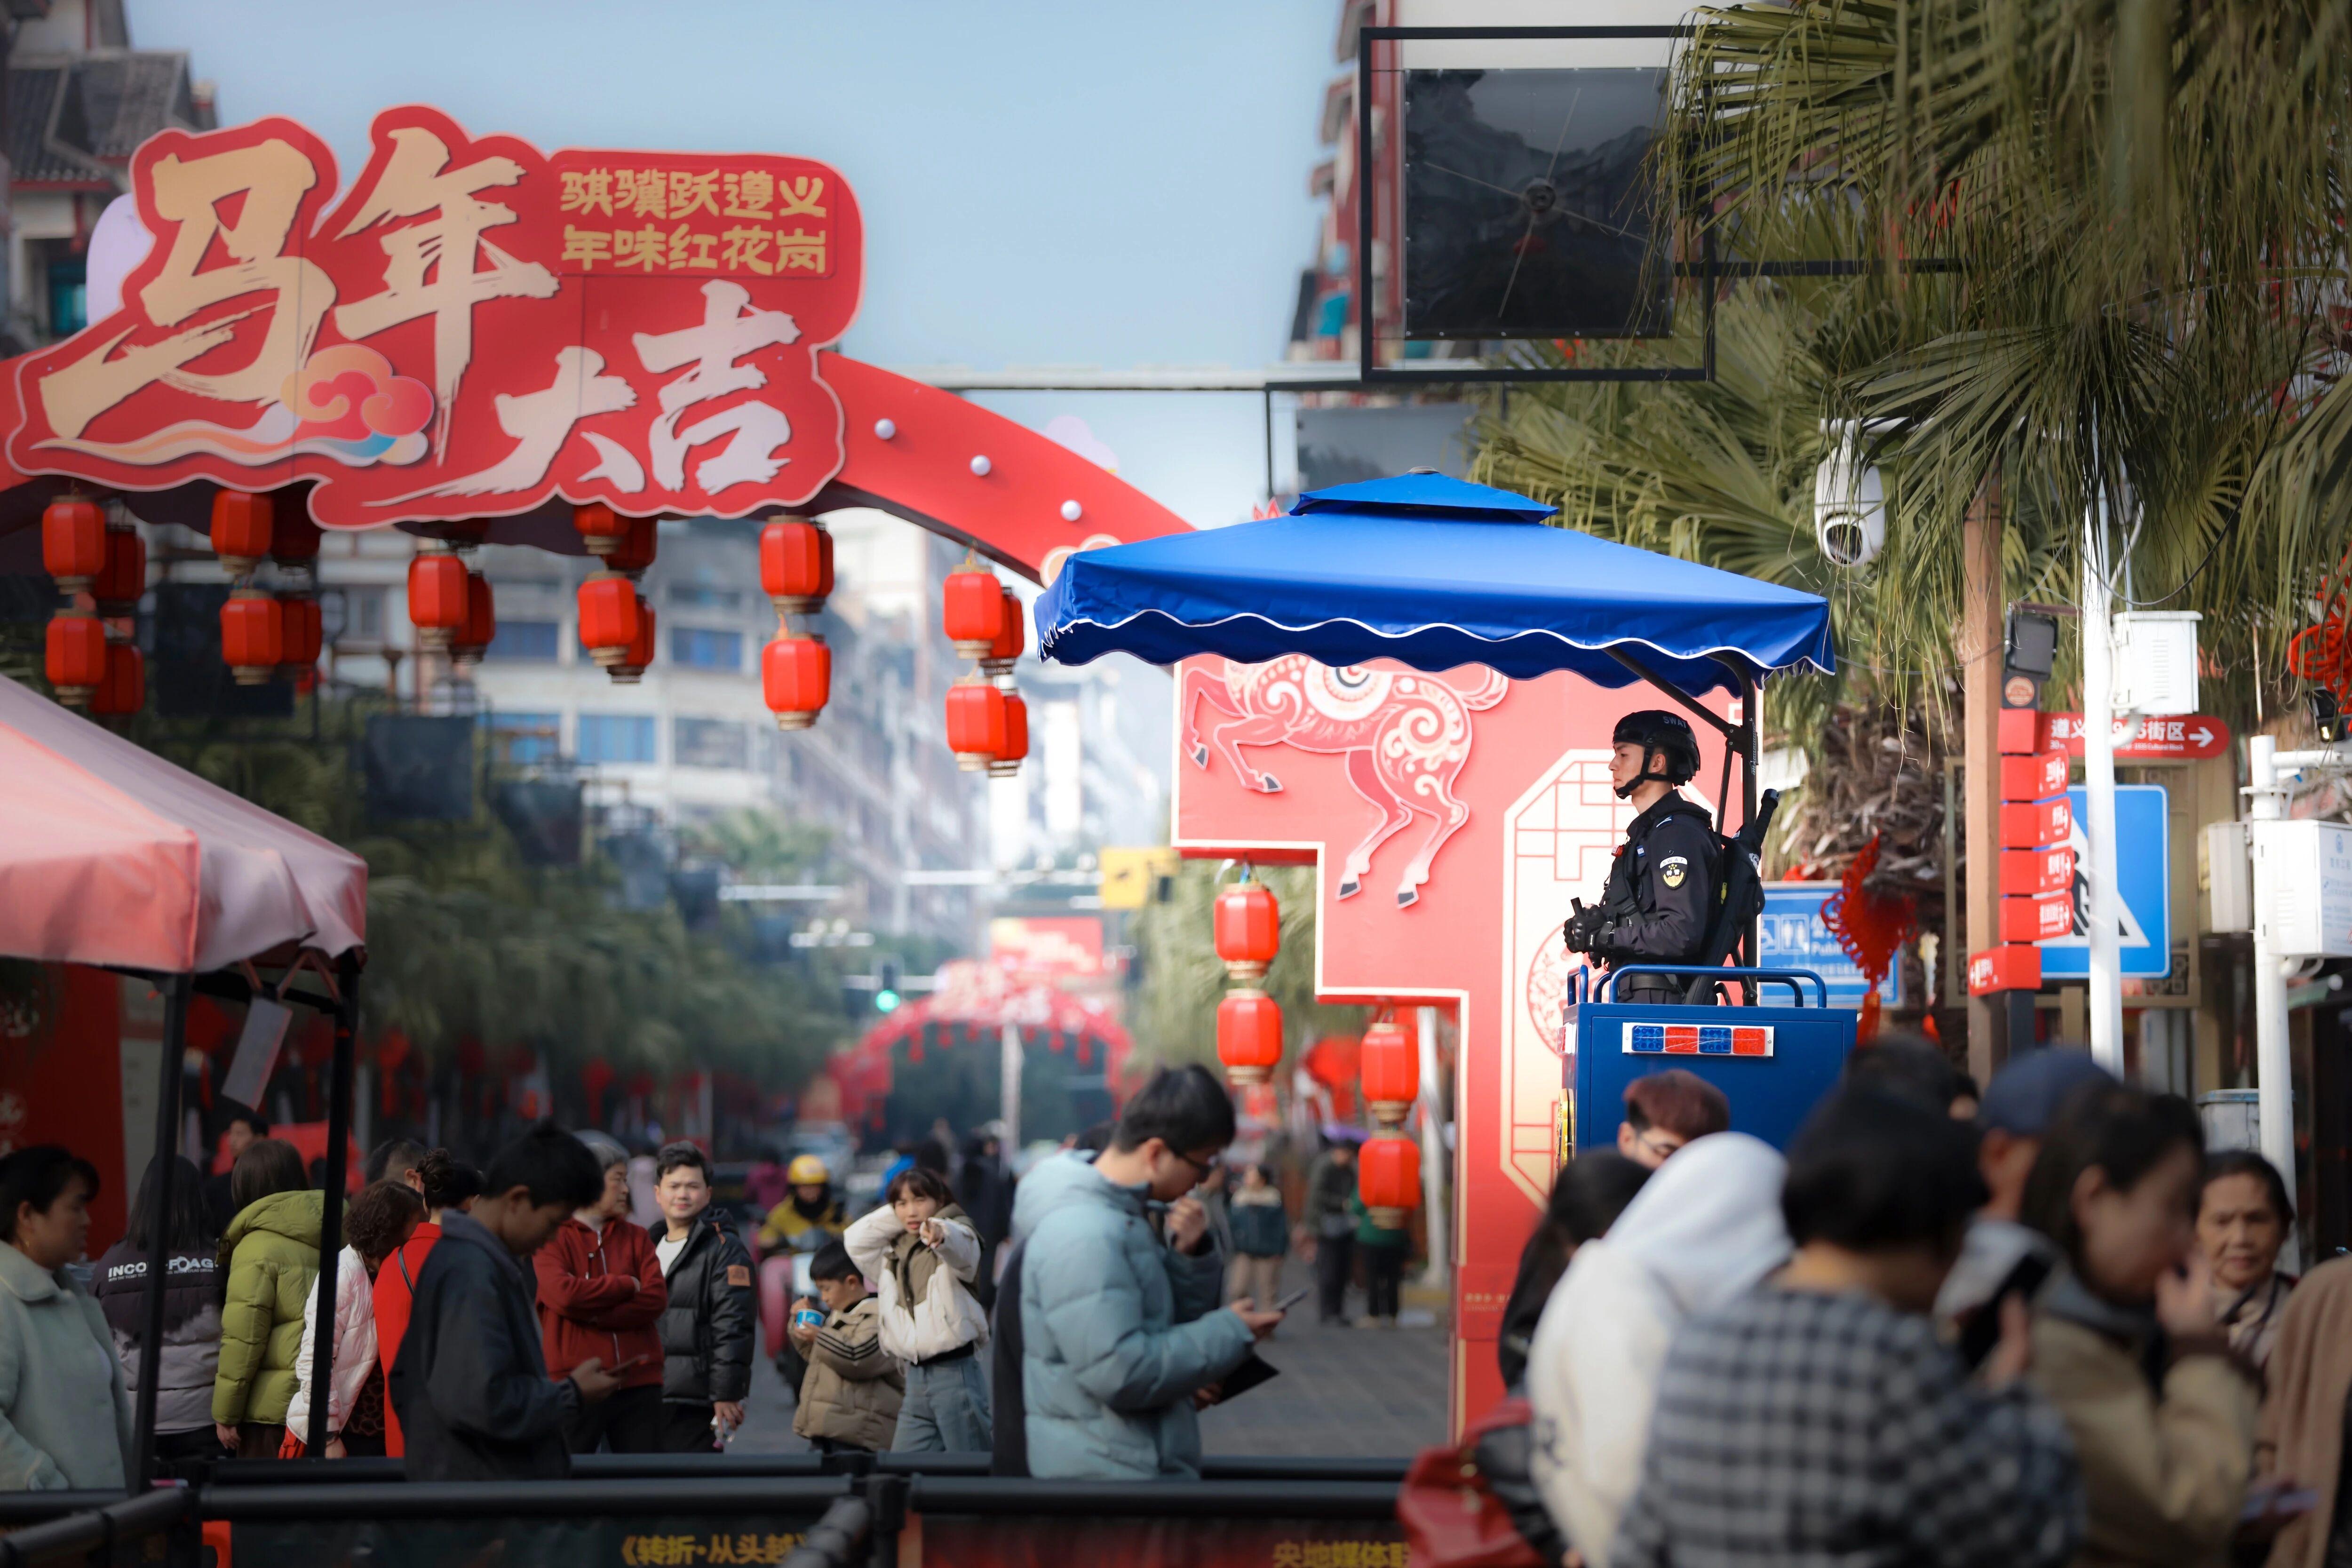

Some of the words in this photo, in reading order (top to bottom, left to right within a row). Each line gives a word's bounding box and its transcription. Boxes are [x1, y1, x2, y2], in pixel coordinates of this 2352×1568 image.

[560, 167, 826, 220] 骐骥跃遵义
[561, 223, 826, 275] 年味红花岗
[39, 127, 560, 467] 马年
[362, 279, 802, 506] 大吉
[1663, 716, 1686, 729] SWAT
[1812, 941, 1843, 955] Publi
[108, 1261, 148, 1278] INCO
